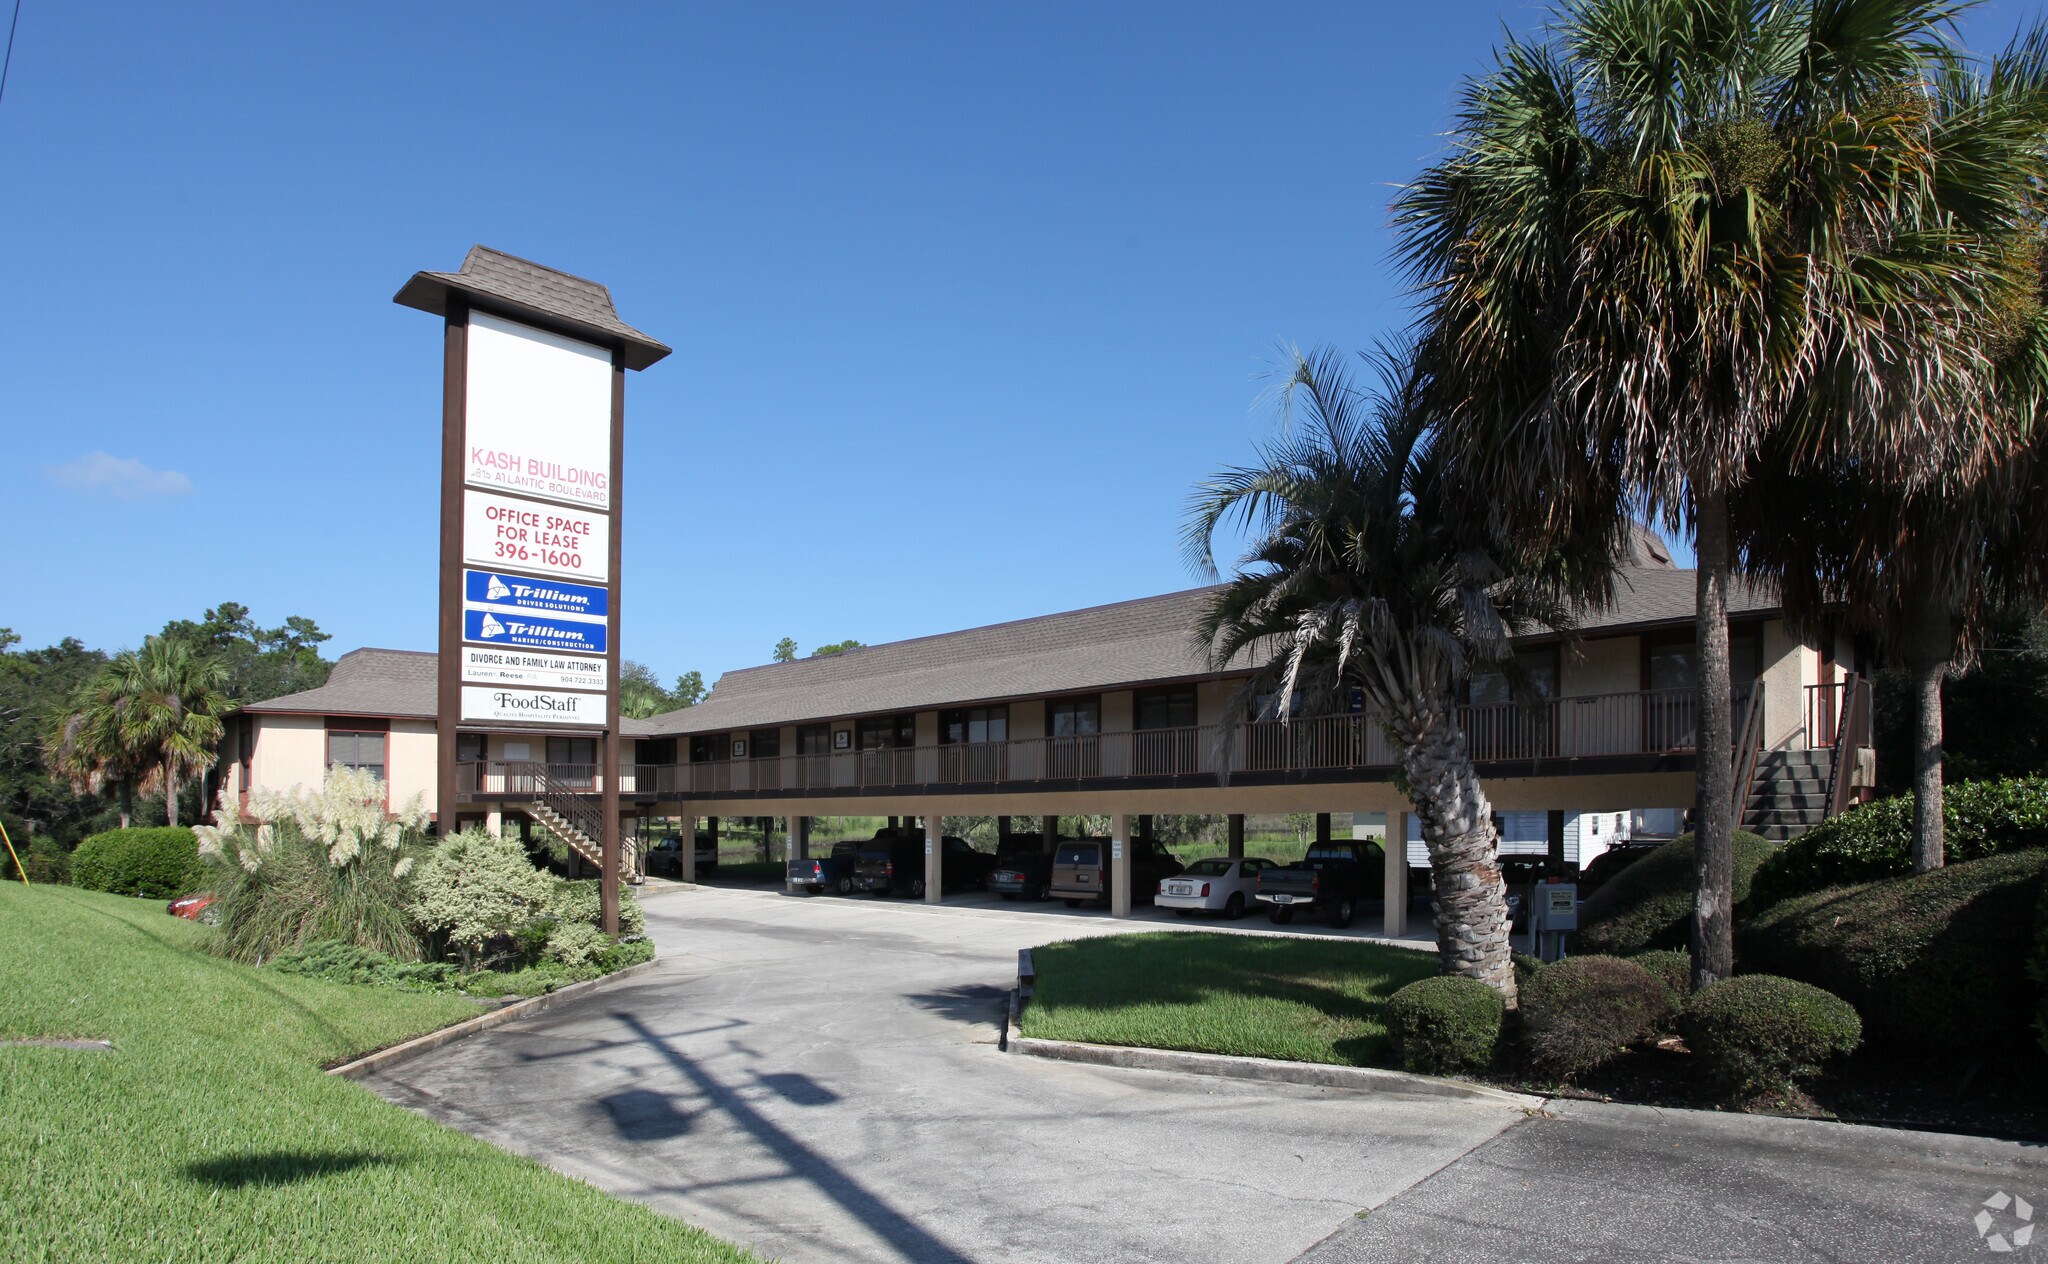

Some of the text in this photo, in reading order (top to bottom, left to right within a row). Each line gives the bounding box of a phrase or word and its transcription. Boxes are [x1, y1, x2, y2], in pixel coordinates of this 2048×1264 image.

[471, 446, 606, 489] KASH BUILDING
[471, 468, 606, 501] 815 ATLANTIC BOULEVARD
[485, 506, 590, 535] OFFICE SPACE
[497, 524, 579, 550] FOR LEASE
[494, 541, 582, 569] 396-1600
[517, 599, 585, 612] DRIVER SOLUTIONS
[511, 636, 595, 650] MARINE/CONSTRUCTION
[470, 652, 602, 673] DIVORCE AND FAMILY LAW ATTORNEY
[467, 669, 493, 677] Lauren
[500, 671, 523, 680] Reese
[560, 675, 604, 686] 904.722.3333
[493, 692, 580, 712] FoodStaff
